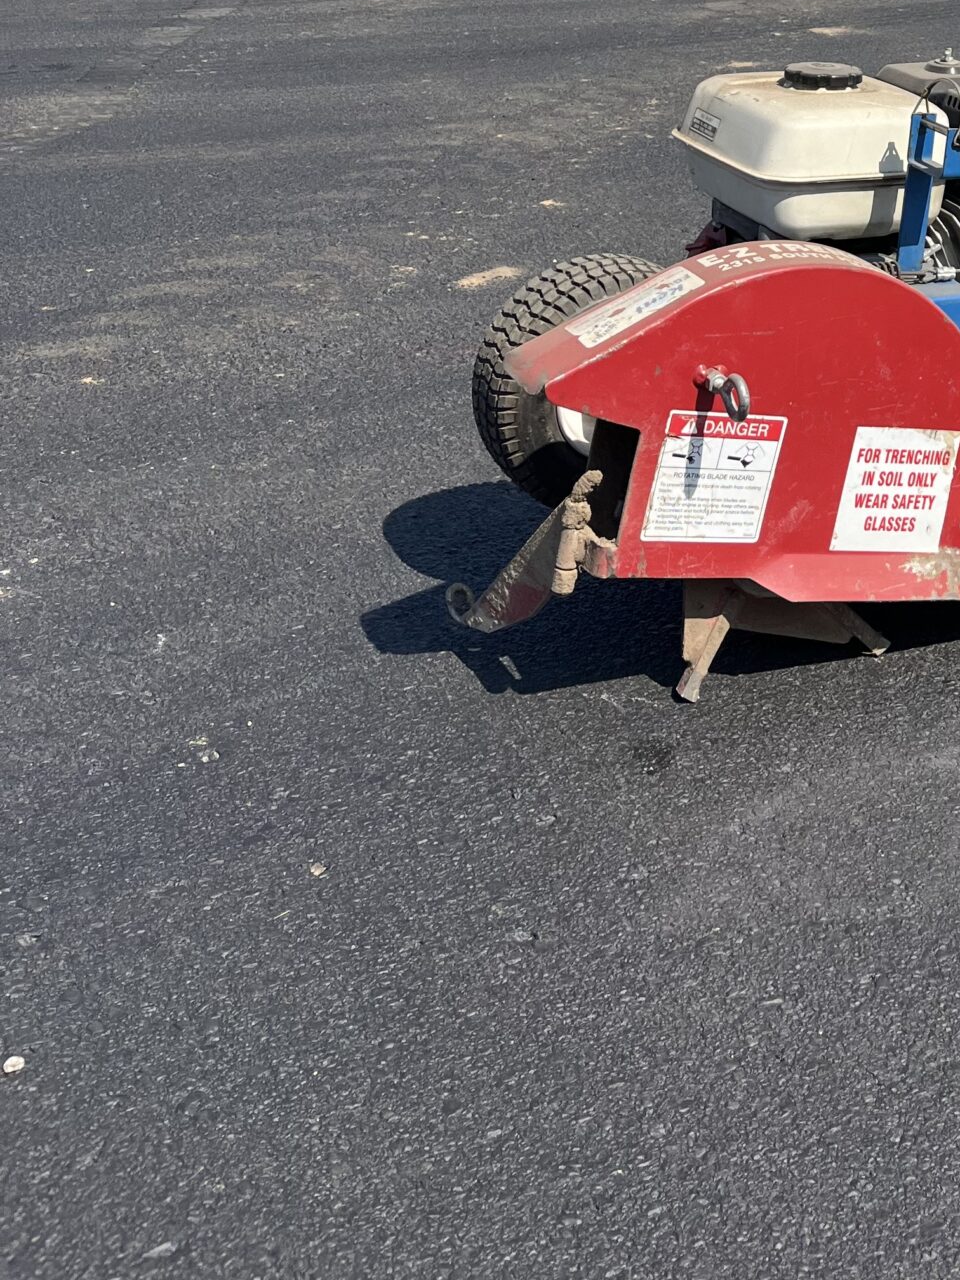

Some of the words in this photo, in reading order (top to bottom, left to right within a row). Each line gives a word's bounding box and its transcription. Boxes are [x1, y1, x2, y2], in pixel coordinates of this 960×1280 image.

[696, 247, 757, 267] E-Z
[718, 256, 766, 272] 2315
[769, 252, 834, 260] SOUTH
[703, 420, 769, 437] DANGER
[857, 448, 881, 463] FOR
[885, 448, 951, 465] TRENCHING
[673, 471, 706, 480] ROTATING
[729, 474, 755, 482] HAZARD
[862, 470, 875, 486] IN
[877, 471, 903, 487] SOIL
[907, 472, 937, 487] ONLY
[854, 493, 889, 508] WEAR
[891, 493, 936, 510] SAFETY
[864, 516, 916, 532] GLASSES
